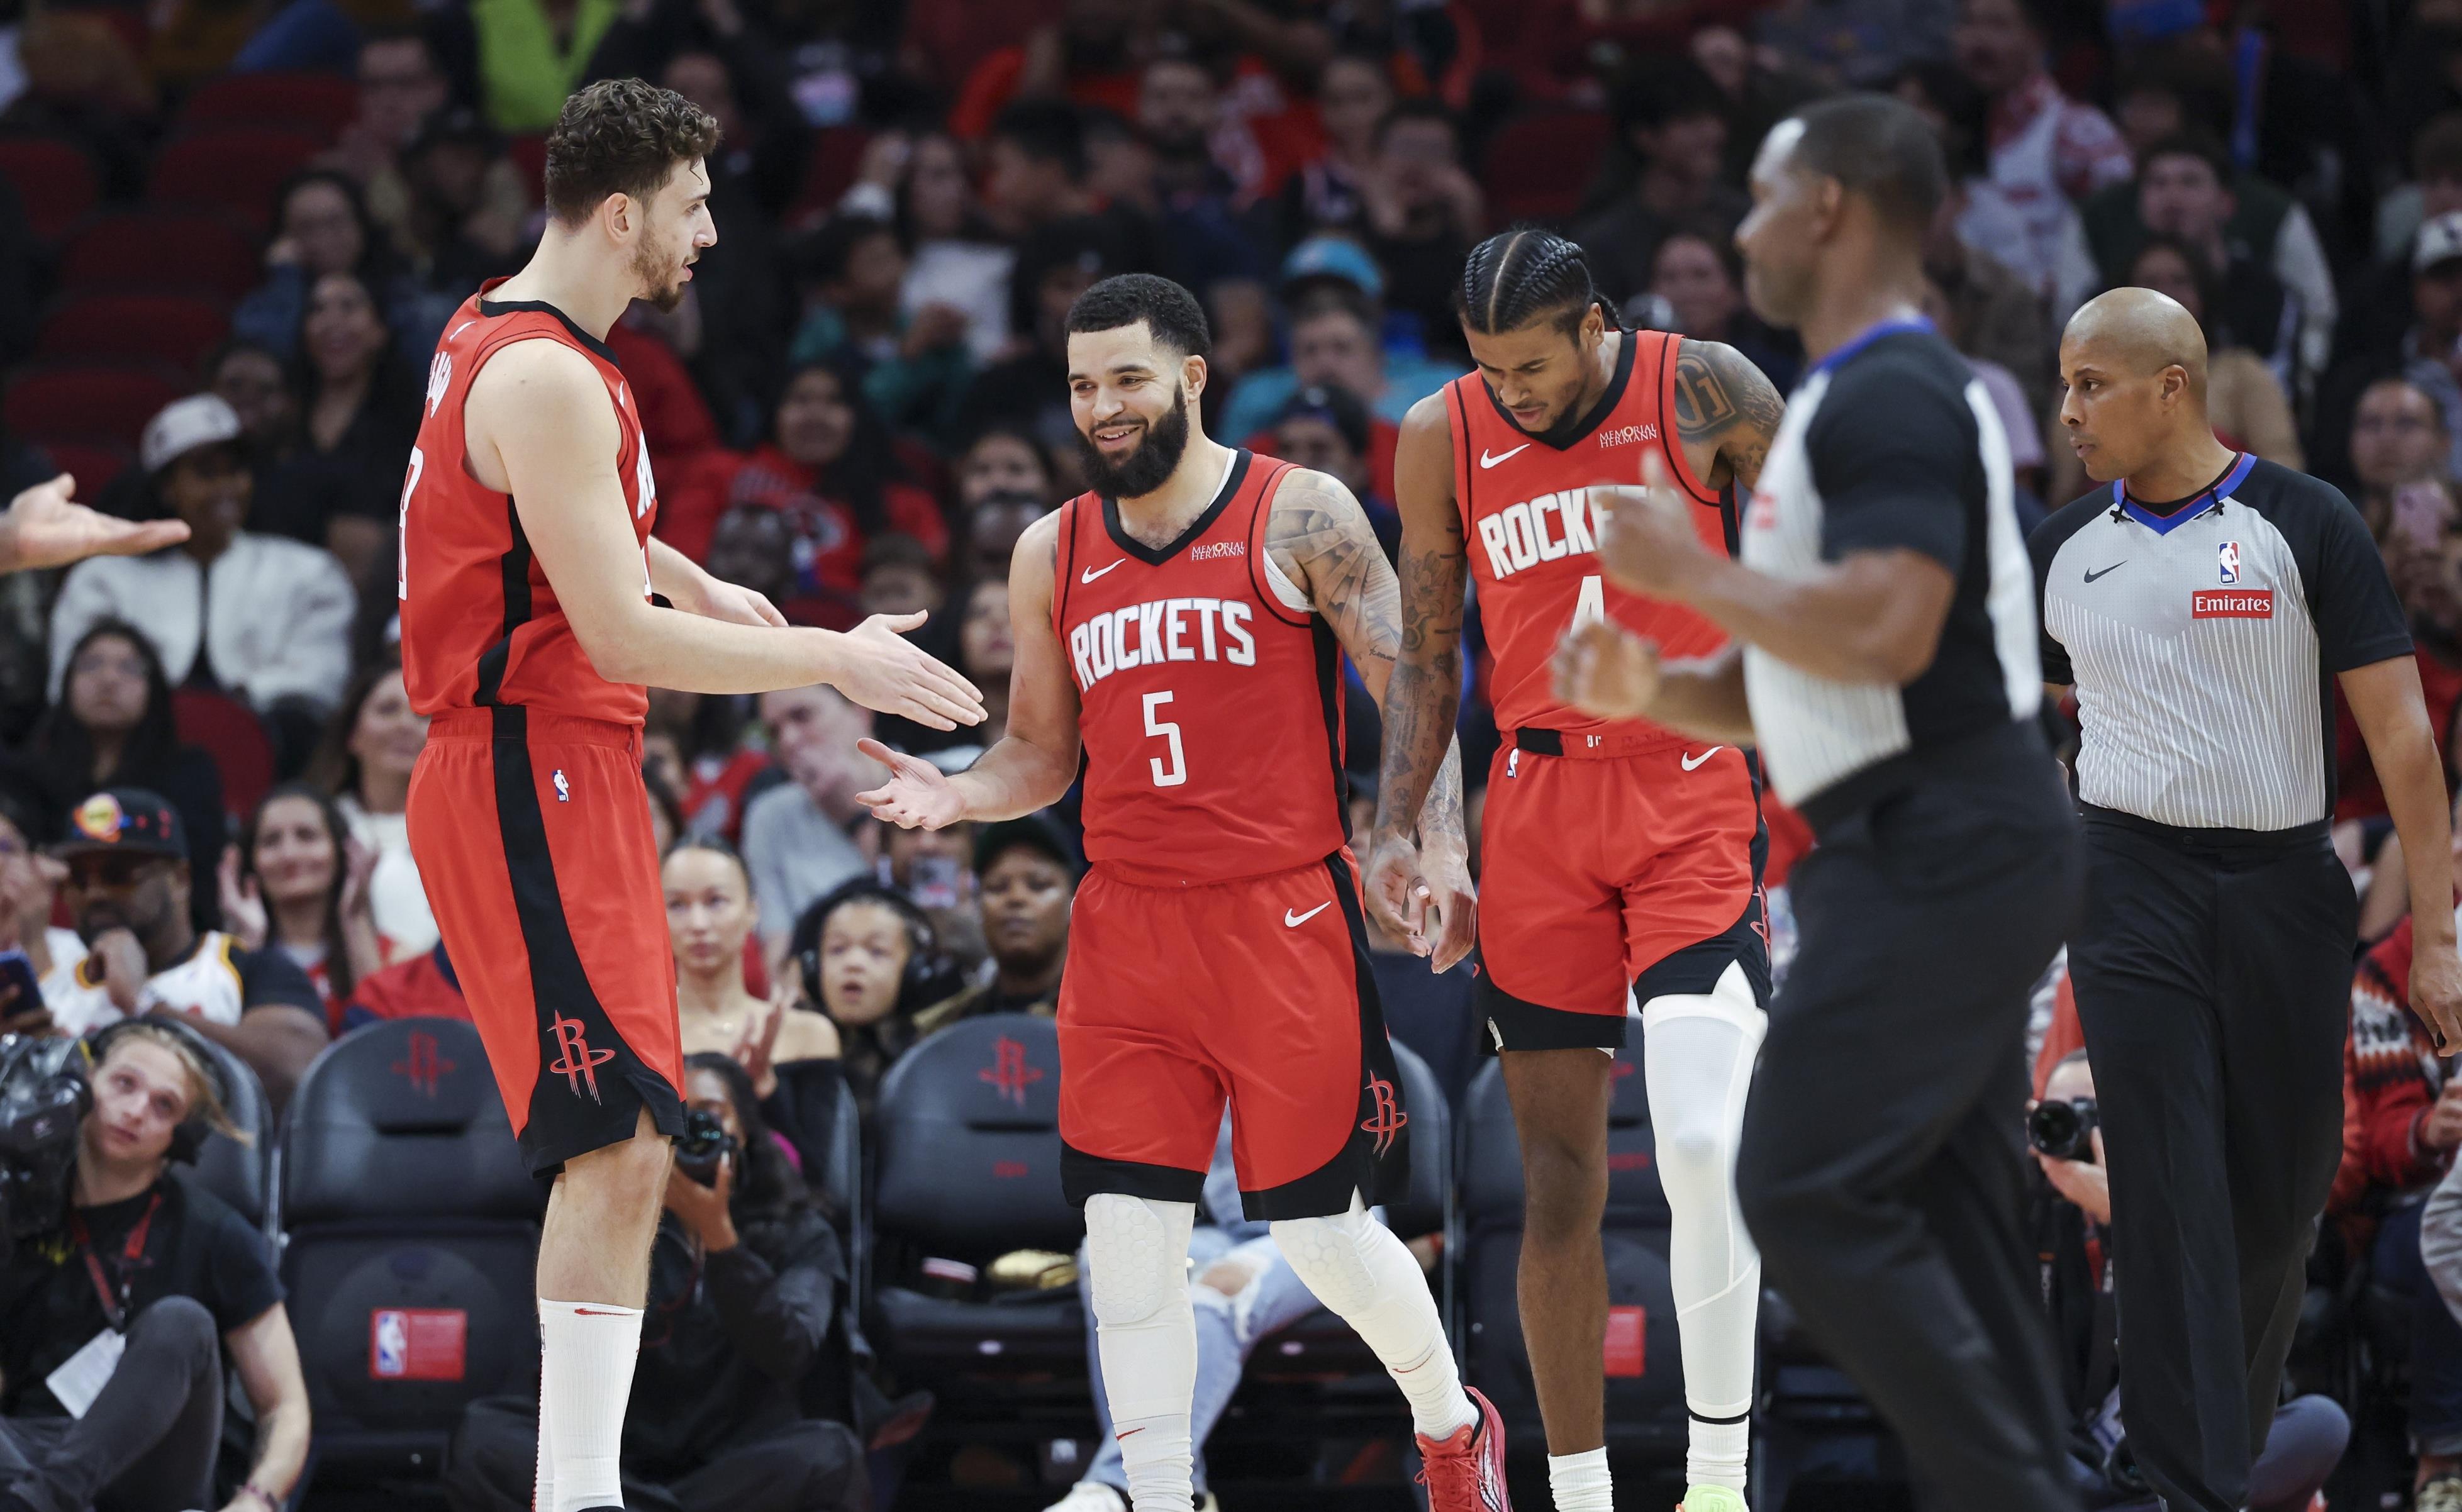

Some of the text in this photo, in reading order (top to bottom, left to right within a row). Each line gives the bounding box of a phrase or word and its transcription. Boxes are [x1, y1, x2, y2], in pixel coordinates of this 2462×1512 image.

[1600, 423, 1657, 441] MEMORIAL
[1600, 430, 1657, 448] HERMANN
[1478, 484, 1648, 581] ROCKE
[1191, 542, 1245, 554] MEMORIAL
[1191, 548, 1244, 561] HERMANN
[2222, 574, 2233, 582] NBA
[2195, 594, 2271, 612] Emirates
[1071, 597, 1256, 694] ROCKETS
[1142, 690, 1187, 787] 5
